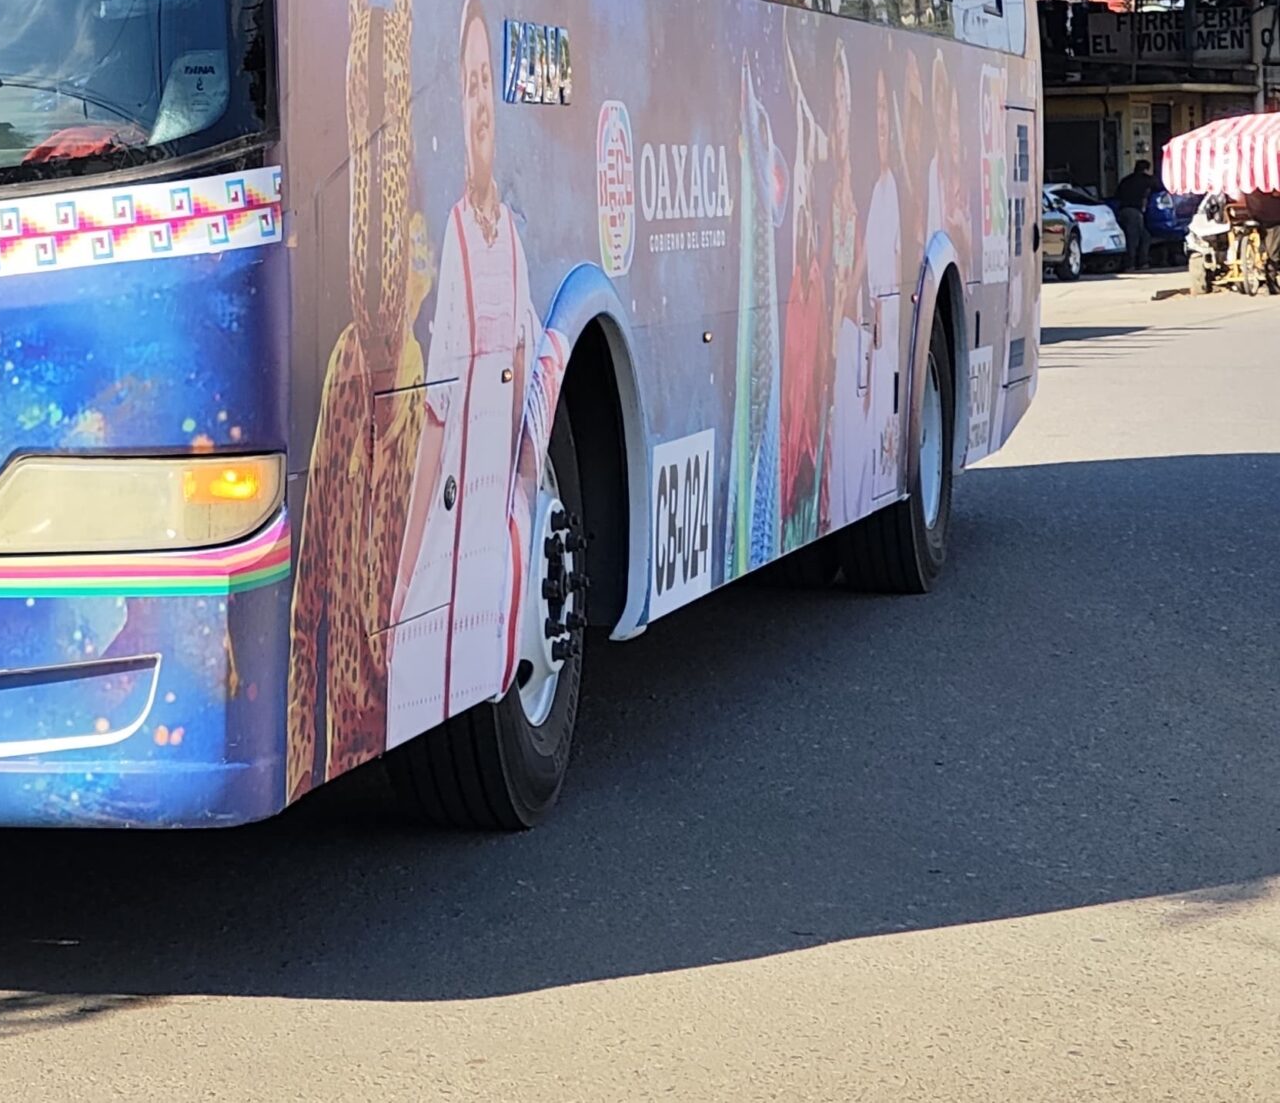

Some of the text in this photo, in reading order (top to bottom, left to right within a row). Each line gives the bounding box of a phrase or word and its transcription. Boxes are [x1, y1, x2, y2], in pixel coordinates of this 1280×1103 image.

[1092, 34, 1118, 55] EL
[640, 142, 732, 222] OAXACA
[649, 228, 726, 253] GOBIERNO DEL ESTADO
[655, 449, 710, 597] CB-024
